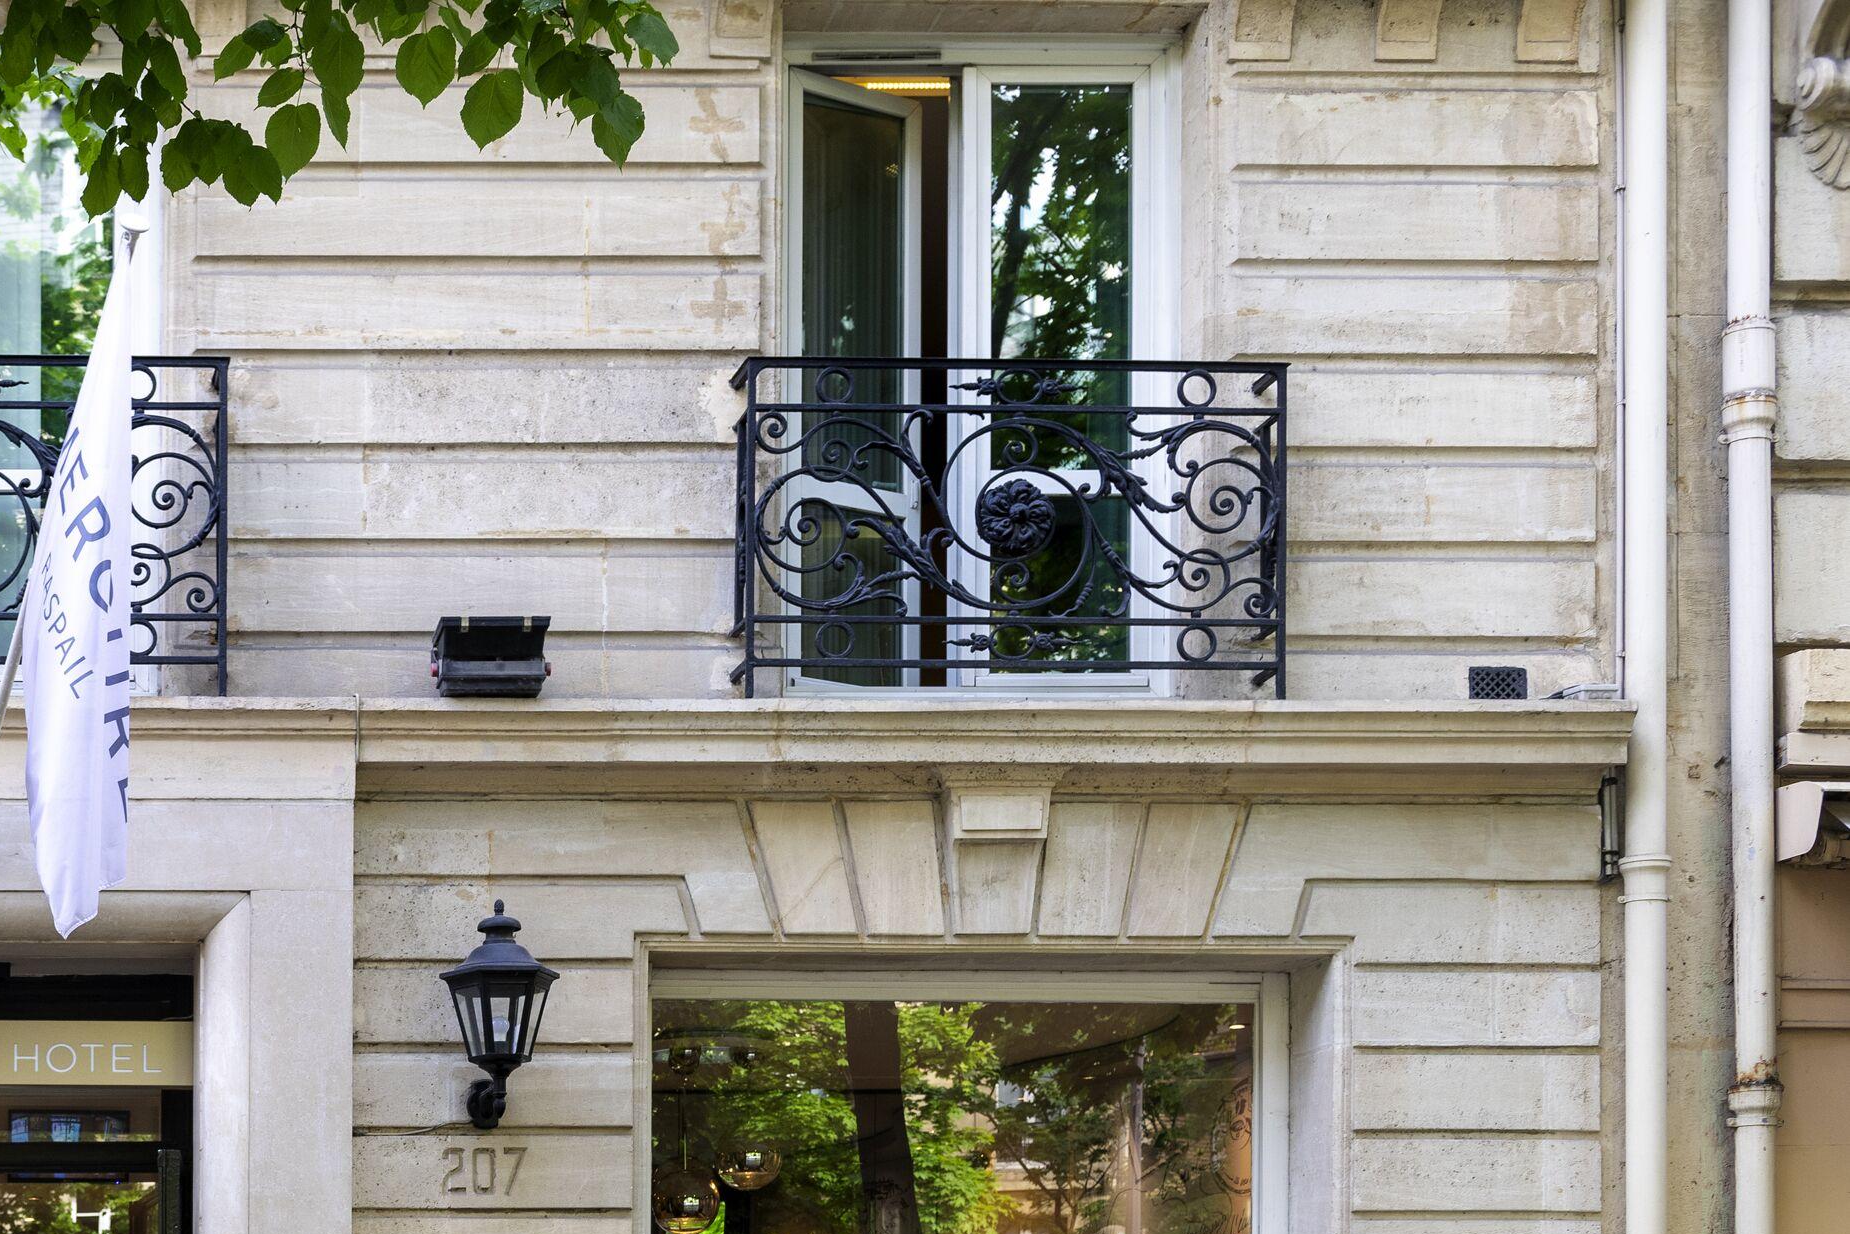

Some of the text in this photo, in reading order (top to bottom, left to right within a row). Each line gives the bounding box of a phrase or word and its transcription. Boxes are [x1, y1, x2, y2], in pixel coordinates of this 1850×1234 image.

[40, 553, 94, 700] RASPAIL
[12, 1043, 162, 1073] HOTEL
[442, 1146, 528, 1196] 207
